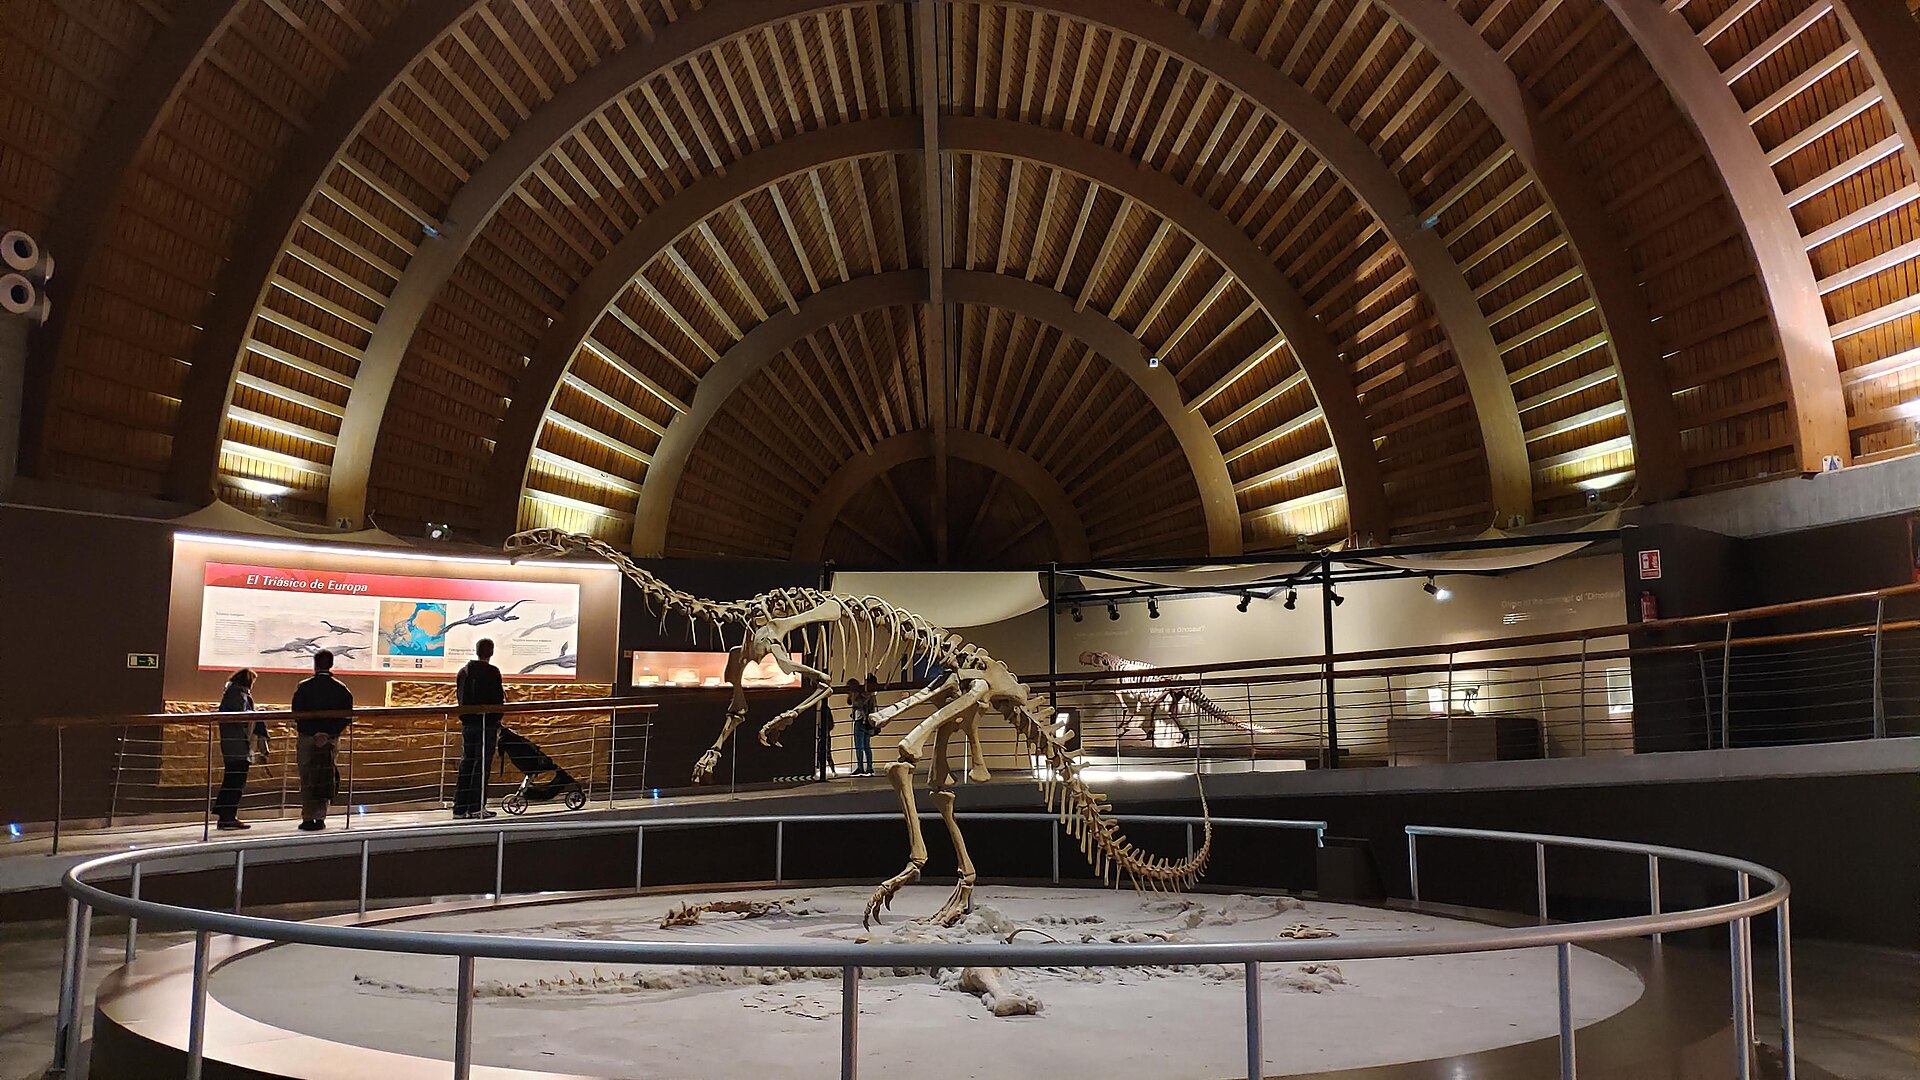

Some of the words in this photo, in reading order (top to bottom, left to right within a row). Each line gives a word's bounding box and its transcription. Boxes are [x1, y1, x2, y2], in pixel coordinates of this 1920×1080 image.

[246, 574, 259, 585] El
[263, 575, 306, 589] Triásico
[310, 578, 325, 589] de
[327, 580, 368, 594] Europa
